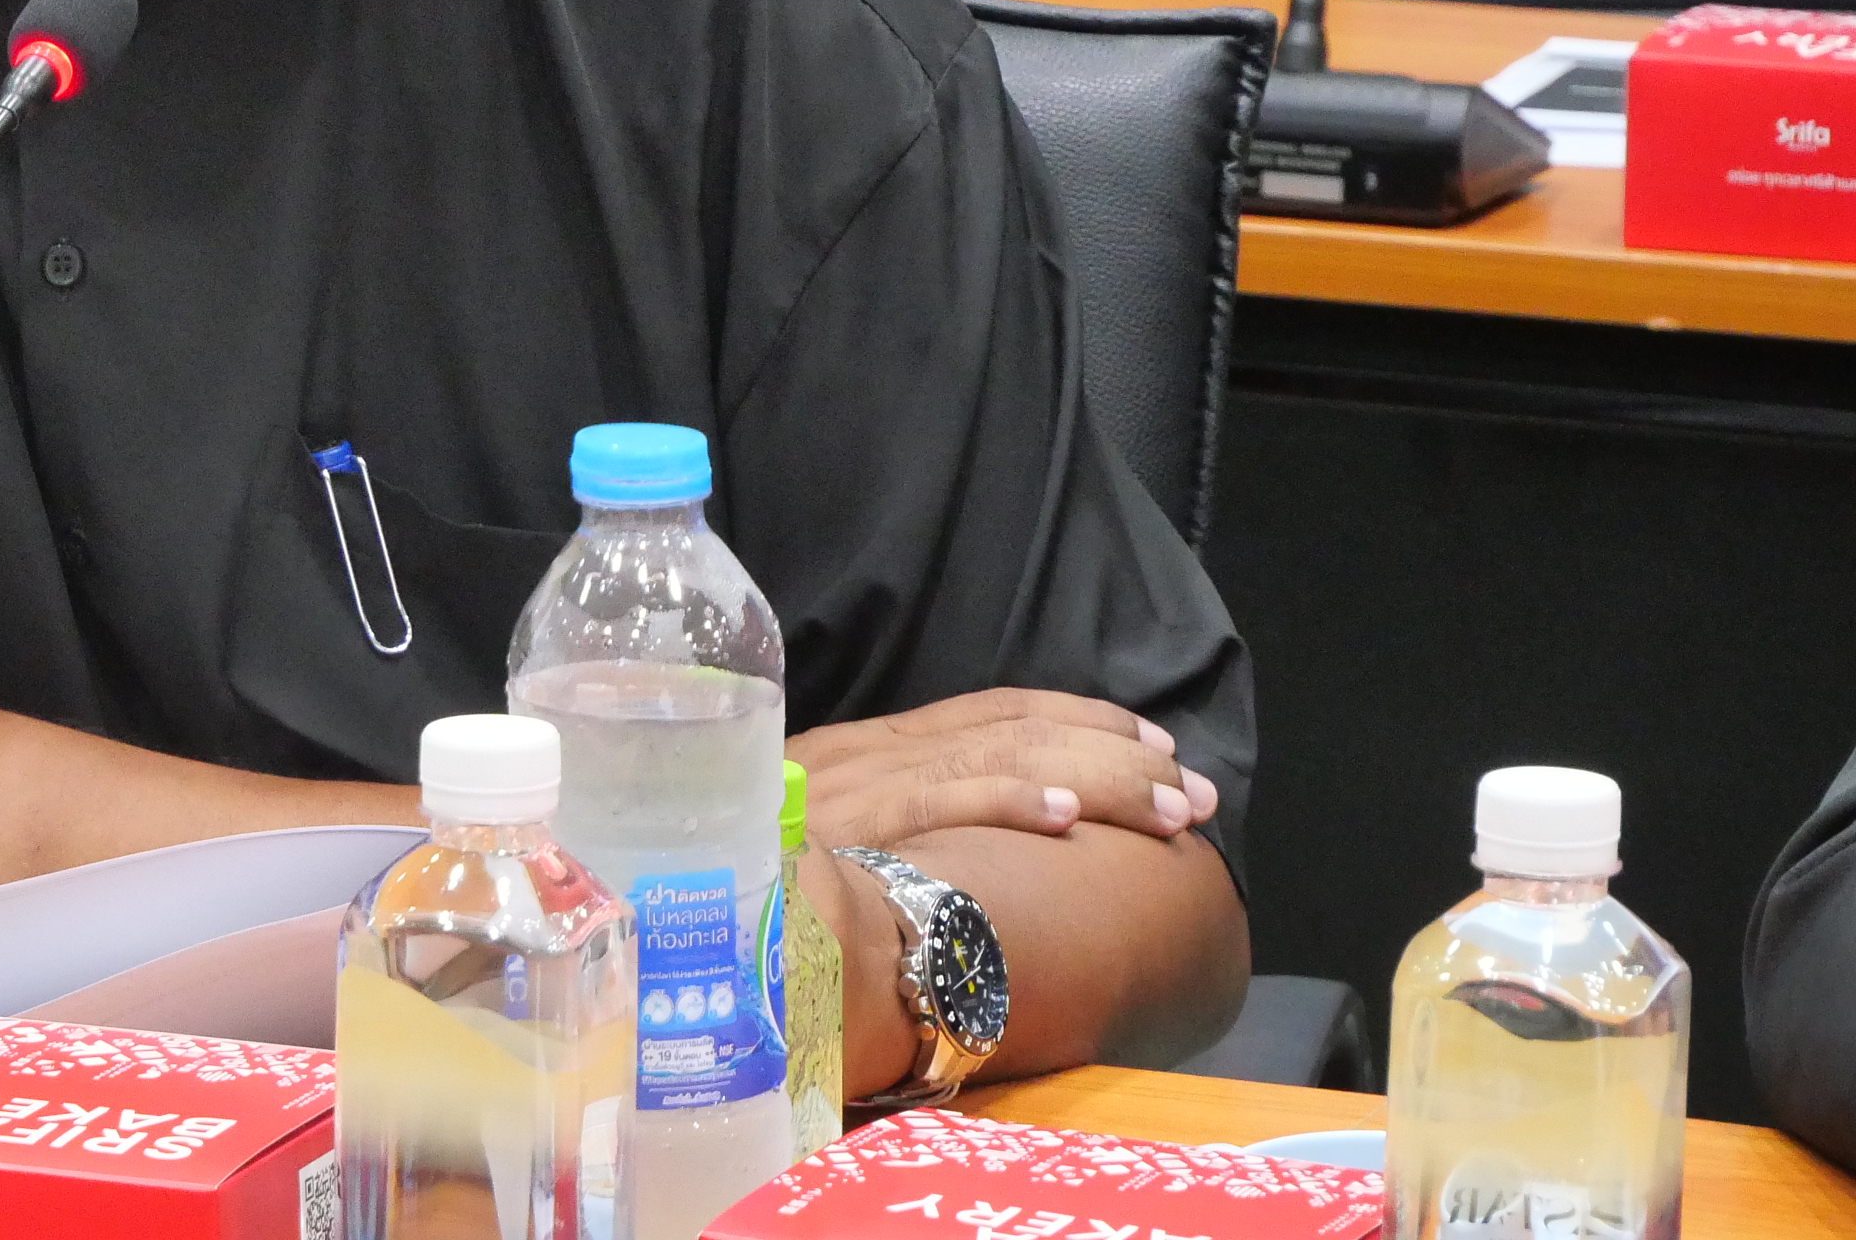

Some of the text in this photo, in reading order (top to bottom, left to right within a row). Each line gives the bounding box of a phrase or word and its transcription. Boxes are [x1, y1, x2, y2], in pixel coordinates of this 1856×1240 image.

[1776, 116, 1831, 148] Srifa
[645, 904, 729, 930] ไม่หลุดลง
[646, 925, 729, 950] ท้องทะเล
[658, 1050, 672, 1062] 19
